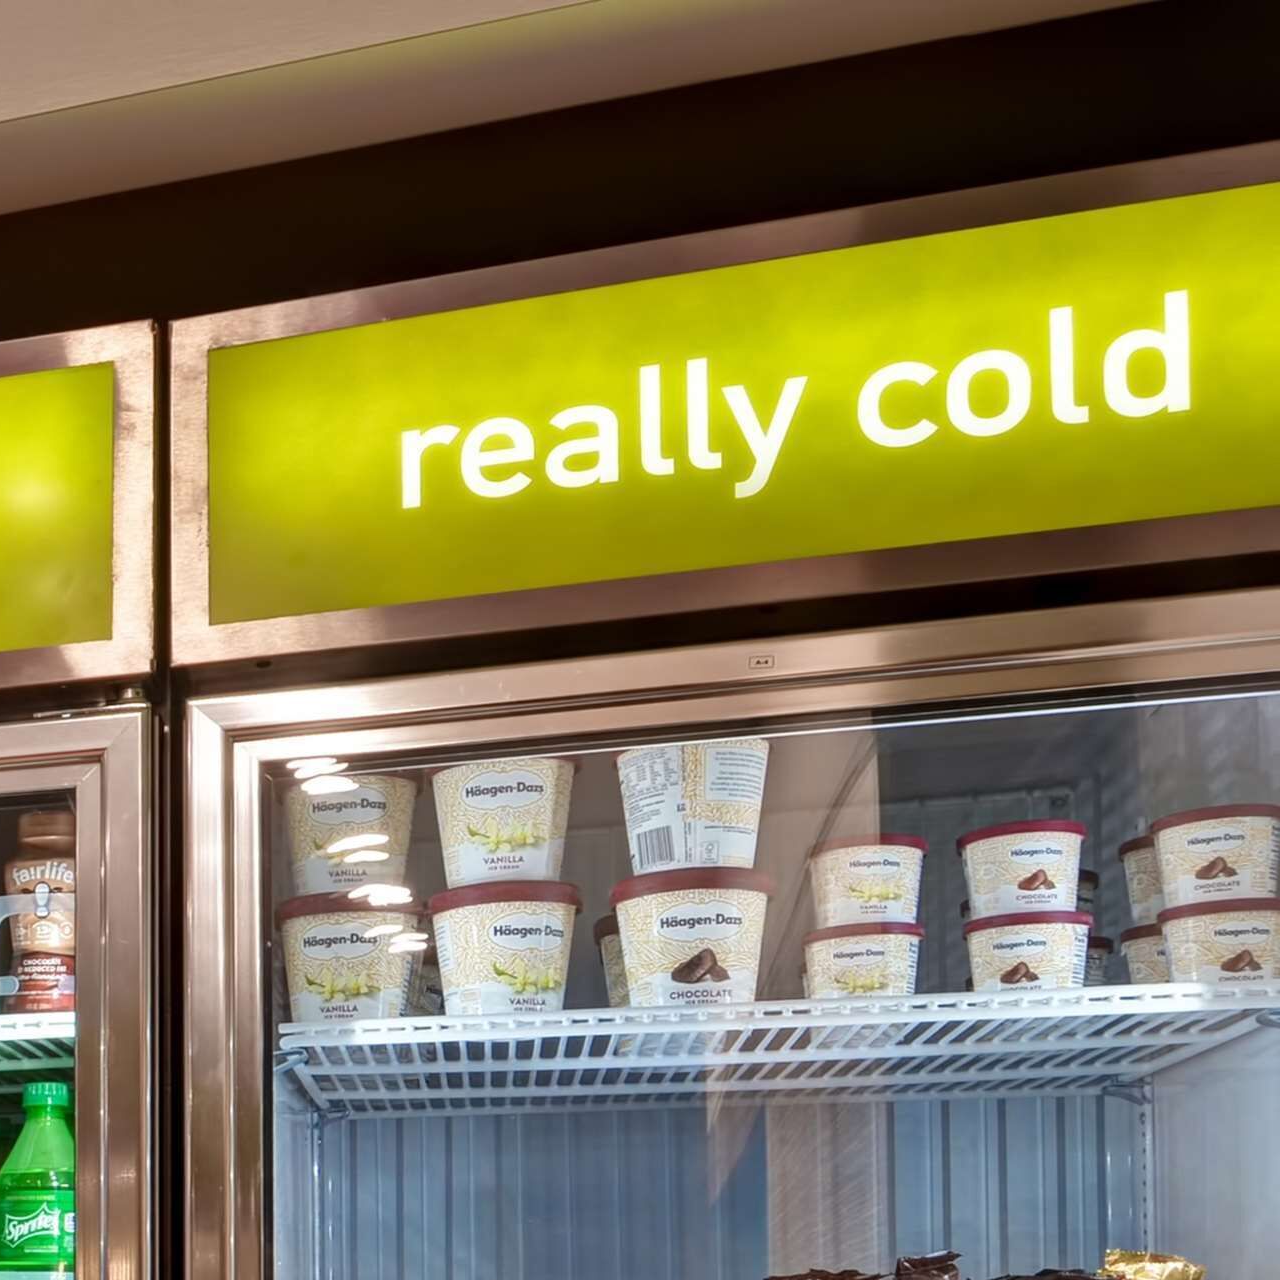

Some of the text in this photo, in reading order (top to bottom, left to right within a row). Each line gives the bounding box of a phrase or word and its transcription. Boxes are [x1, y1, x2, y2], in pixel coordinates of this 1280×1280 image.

[400, 289, 1192, 510] really cold
[464, 781, 544, 799] Häagen-Dazs
[482, 854, 525, 867] VANILLA
[1193, 880, 1241, 892] CHOCOLATE
[659, 913, 743, 932] Häagen-Dazs
[669, 989, 733, 1001] CHOCOLATE
[319, 1003, 359, 1014] VANILLA
